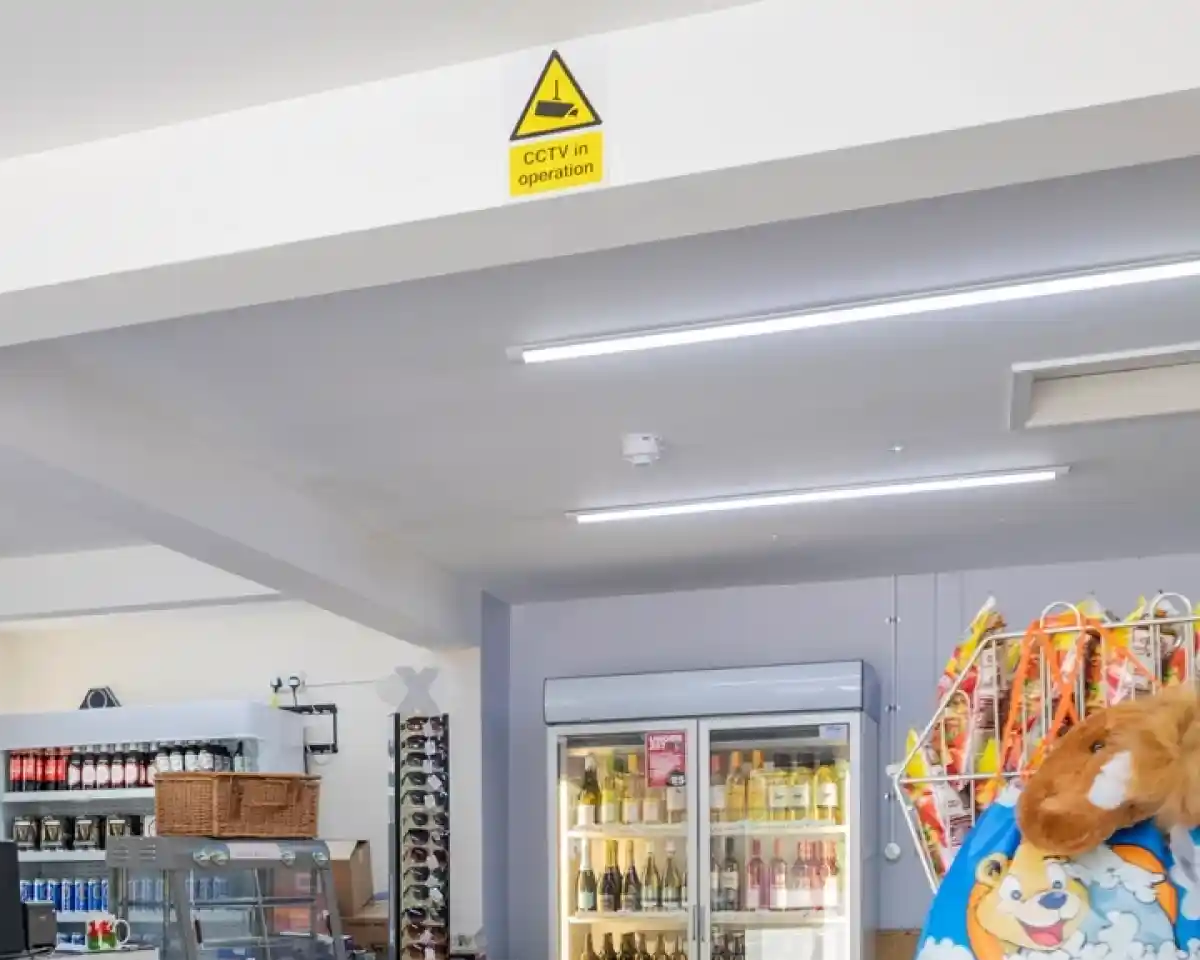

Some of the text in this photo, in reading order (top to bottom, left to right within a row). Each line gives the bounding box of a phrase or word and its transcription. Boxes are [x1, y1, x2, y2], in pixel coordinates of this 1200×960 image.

[523, 143, 589, 165] CCTV in
[518, 162, 594, 187] operation
